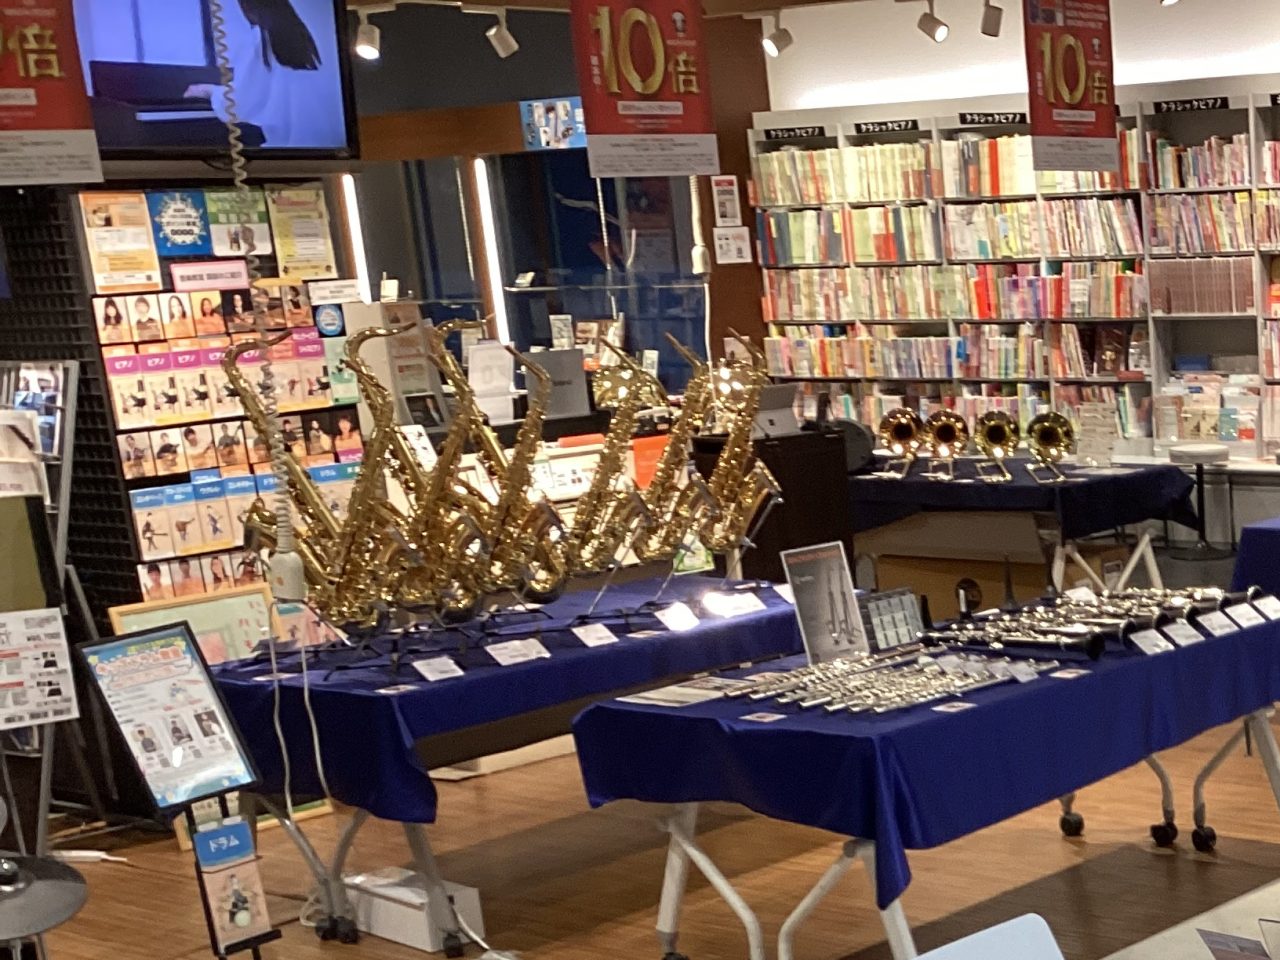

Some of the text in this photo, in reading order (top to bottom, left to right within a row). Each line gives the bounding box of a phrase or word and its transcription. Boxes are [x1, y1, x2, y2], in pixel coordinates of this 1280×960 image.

[0, 23, 64, 77] 倍
[1160, 98, 1222, 112] クラシックピアノ
[965, 113, 1021, 124] クラシックピアノ
[770, 127, 820, 138] クラシックピアノ
[860, 120, 913, 133] クラシックピアノ
[209, 835, 240, 852] ドラム
